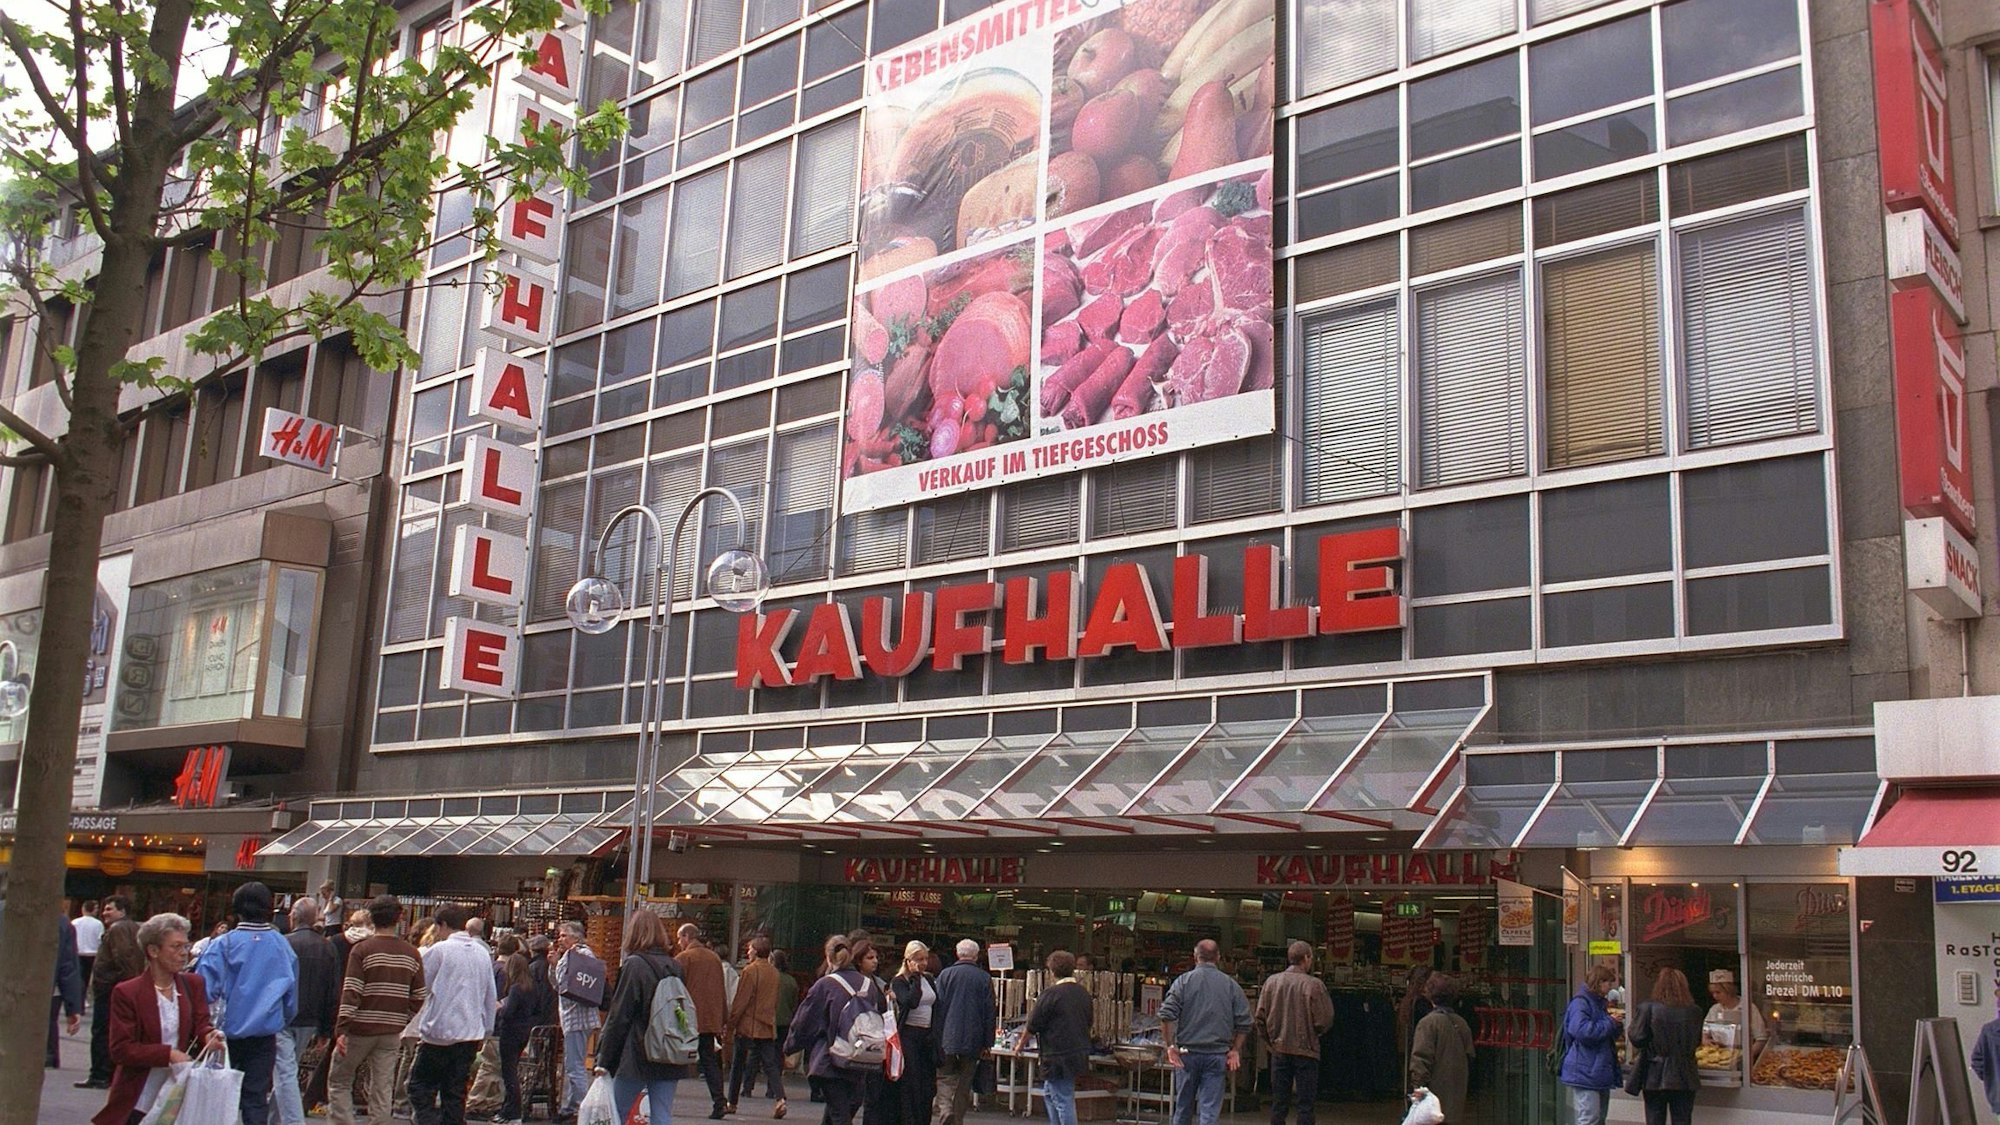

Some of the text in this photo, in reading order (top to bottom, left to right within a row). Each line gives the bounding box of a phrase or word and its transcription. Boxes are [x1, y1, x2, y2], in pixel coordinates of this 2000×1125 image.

[271, 416, 335, 468] H&M
[919, 421, 1168, 492] VERKAUF IM TIEFGESCHOSS
[1946, 541, 1980, 597] SNACK
[736, 526, 1406, 690] KAUFHALLE
[845, 857, 1026, 884] KAUFHALLE
[1942, 850, 1978, 873] 92
[892, 891, 942, 904] KASSE KASSE
[1766, 960, 1805, 971] Jederzeit
[576, 971, 597, 988] spy
[1766, 972, 1814, 983] ofenfrische
[1766, 984, 1843, 998] Brezel DM 1.10
